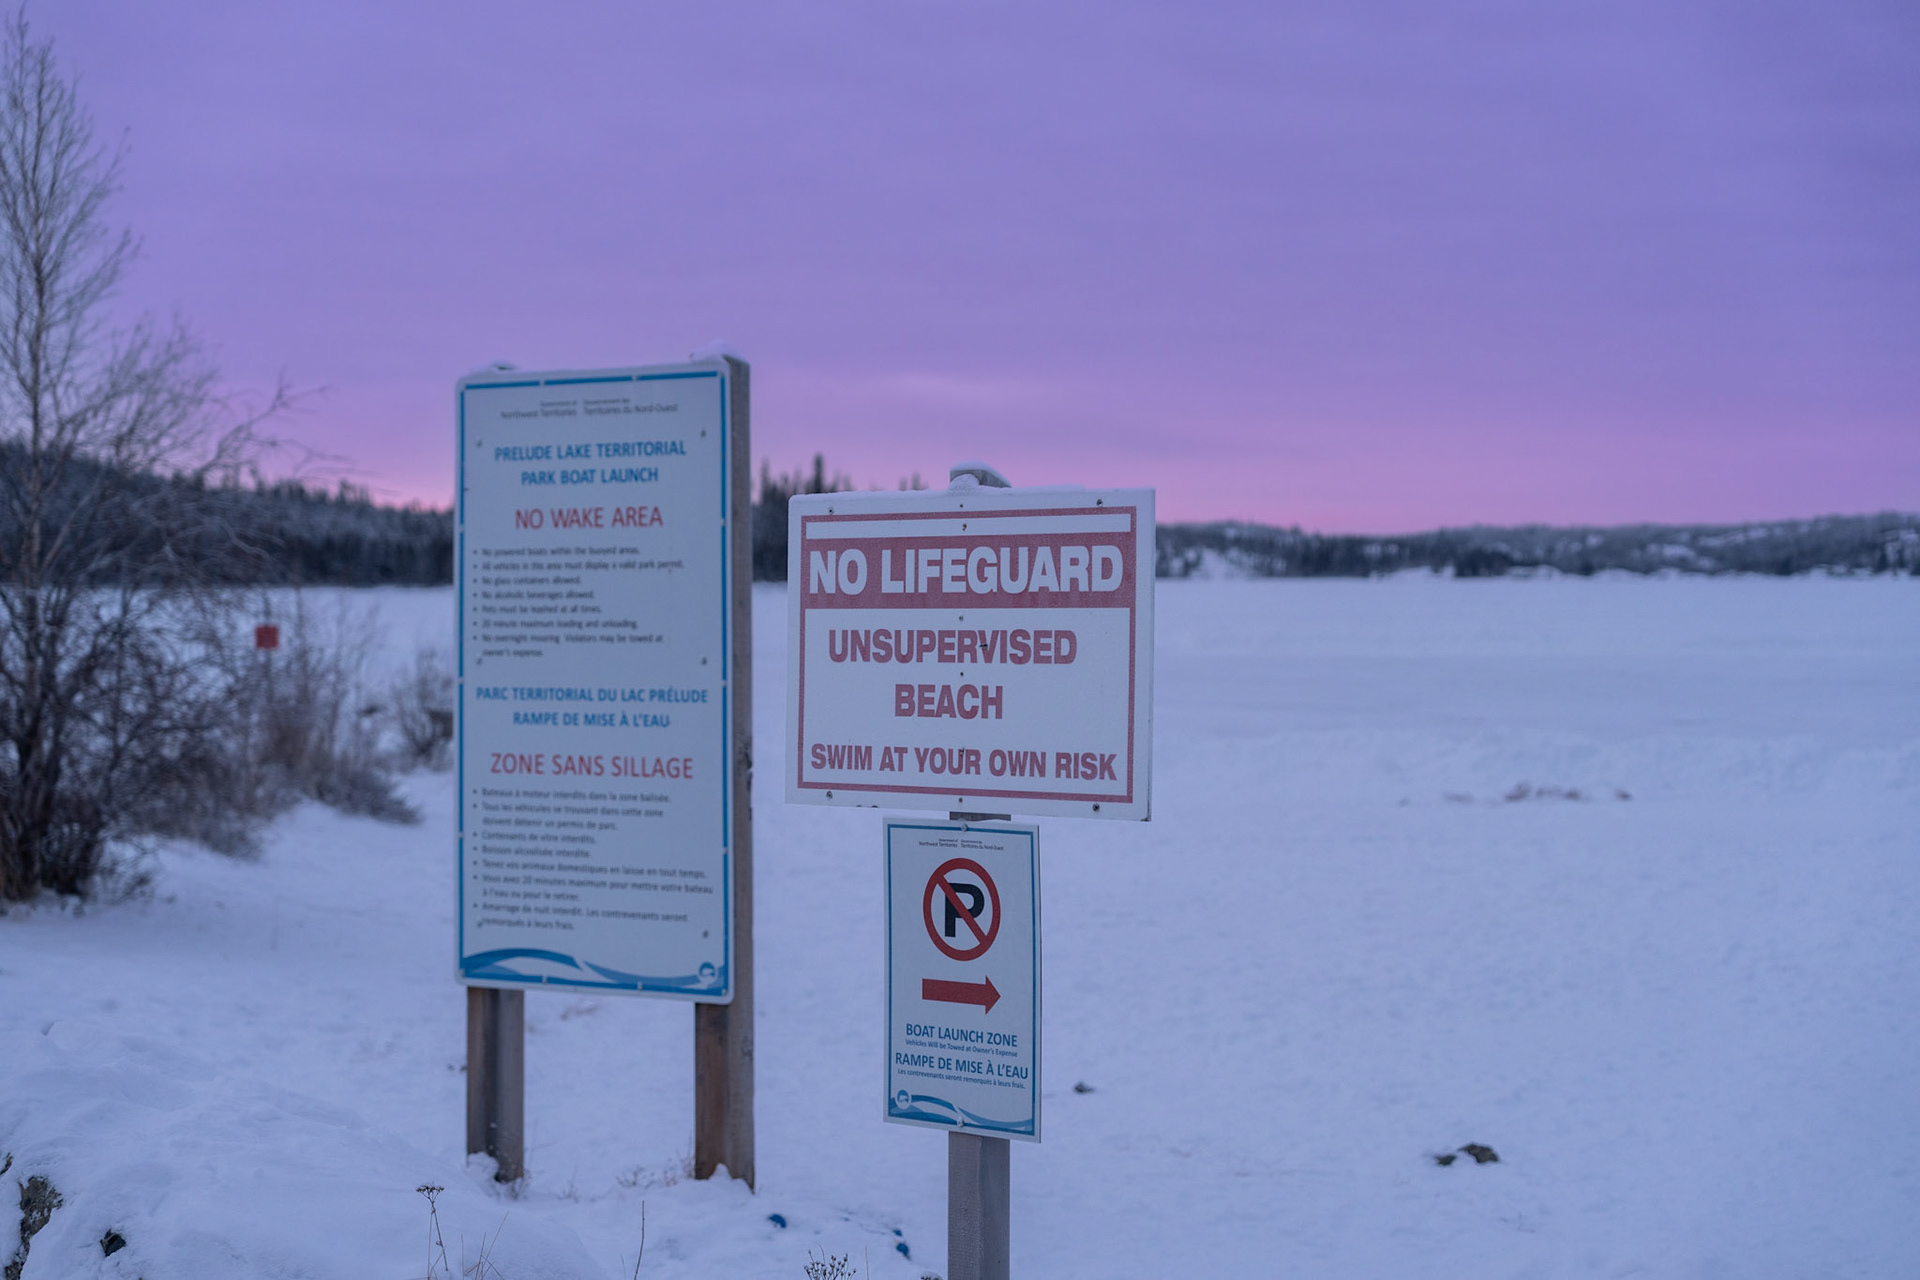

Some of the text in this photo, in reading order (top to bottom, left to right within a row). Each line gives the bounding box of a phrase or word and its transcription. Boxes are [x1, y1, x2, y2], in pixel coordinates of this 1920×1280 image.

[495, 440, 686, 461] PRELUDE LAKE TERRITORIAL
[522, 468, 658, 485] PARK BOAT LAUNCH
[516, 506, 663, 529] NO WAKE AREA
[809, 545, 1124, 595] NO LIFEGUARD
[829, 628, 1078, 665] UNSUPERVISED
[476, 685, 708, 703] PARC TERRITORIAL DU LAC PRÉLUDE
[895, 684, 1003, 719] BEACH
[513, 712, 558, 725] RAMPE
[564, 713, 579, 726] DE
[584, 713, 614, 726] MISE
[620, 710, 629, 726] À
[491, 753, 693, 779] ZONE SANS SILLAGE
[811, 743, 1117, 780] SWIM AT YOUR OWN RISK
[906, 1023, 1017, 1047] BOAT LAUNCH ZONE
[906, 1038, 927, 1047] Vehicles
[948, 1044, 964, 1052] Towed
[996, 1049, 1017, 1057] Expense
[895, 1053, 934, 1068] RAMPE
[938, 1057, 952, 1070] DE
[956, 1059, 983, 1074] MISE
[986, 1060, 994, 1075] À
[907, 1070, 944, 1080] contrevenants
[945, 1074, 962, 1082] seront
[964, 1076, 992, 1086] remorqués
[998, 1080, 1011, 1088] leurs
